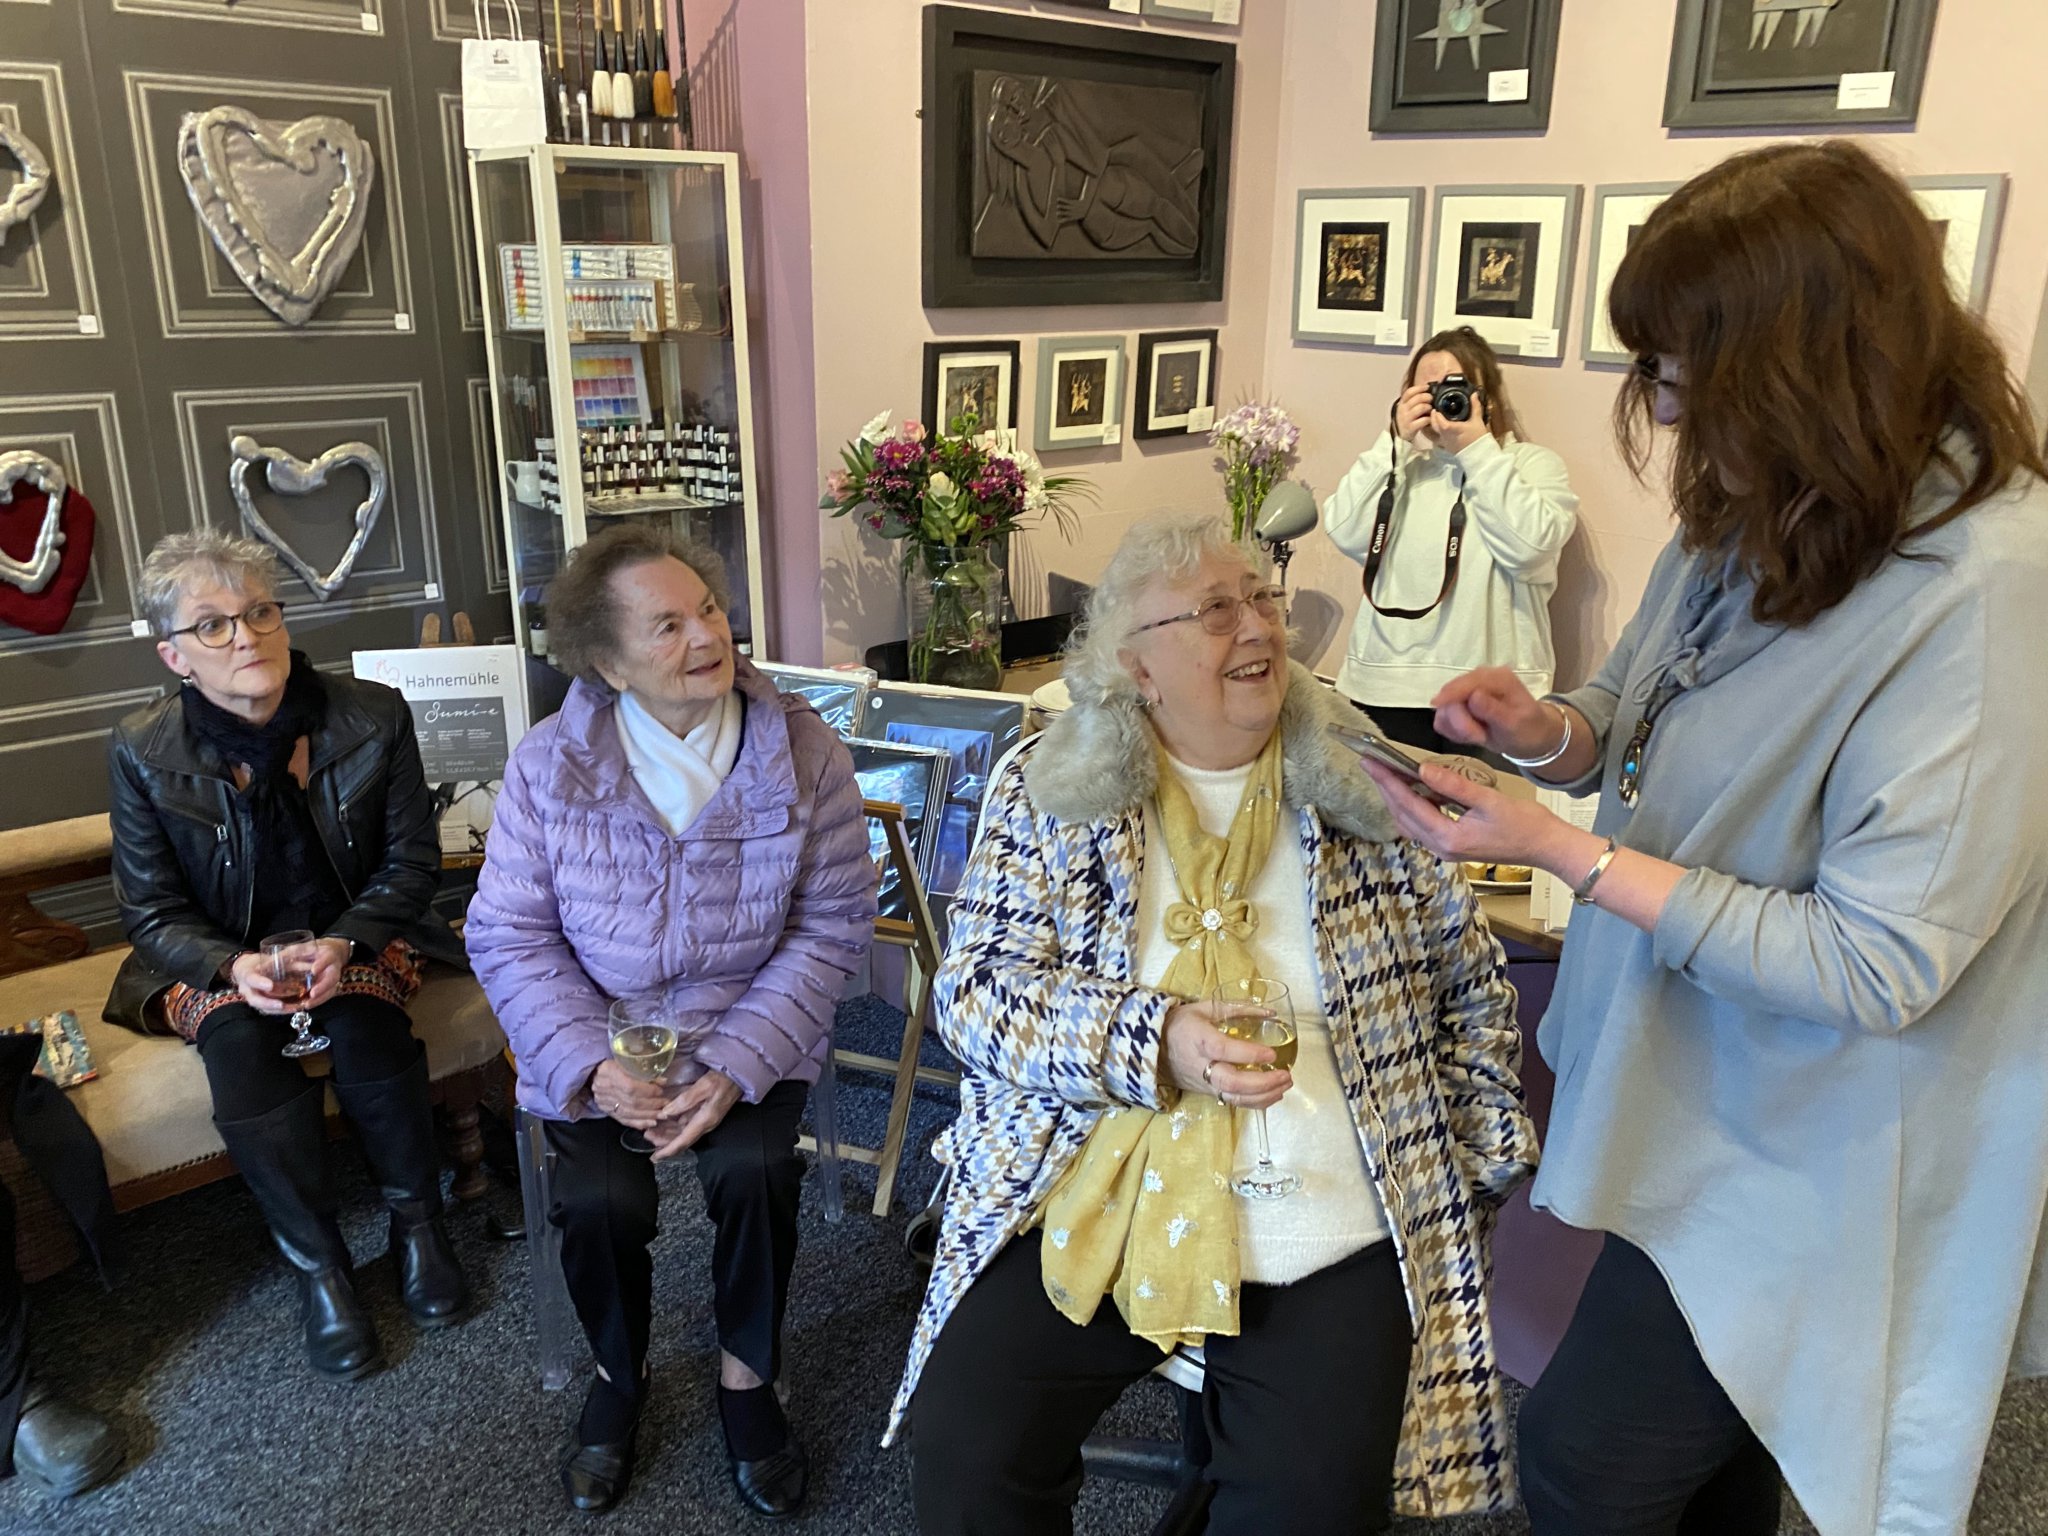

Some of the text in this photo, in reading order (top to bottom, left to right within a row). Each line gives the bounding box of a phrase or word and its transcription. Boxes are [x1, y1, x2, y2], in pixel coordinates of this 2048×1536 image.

[1372, 523, 1386, 554] Canon
[1448, 536, 1459, 558] EOS
[406, 672, 499, 688] Hahnemühle
